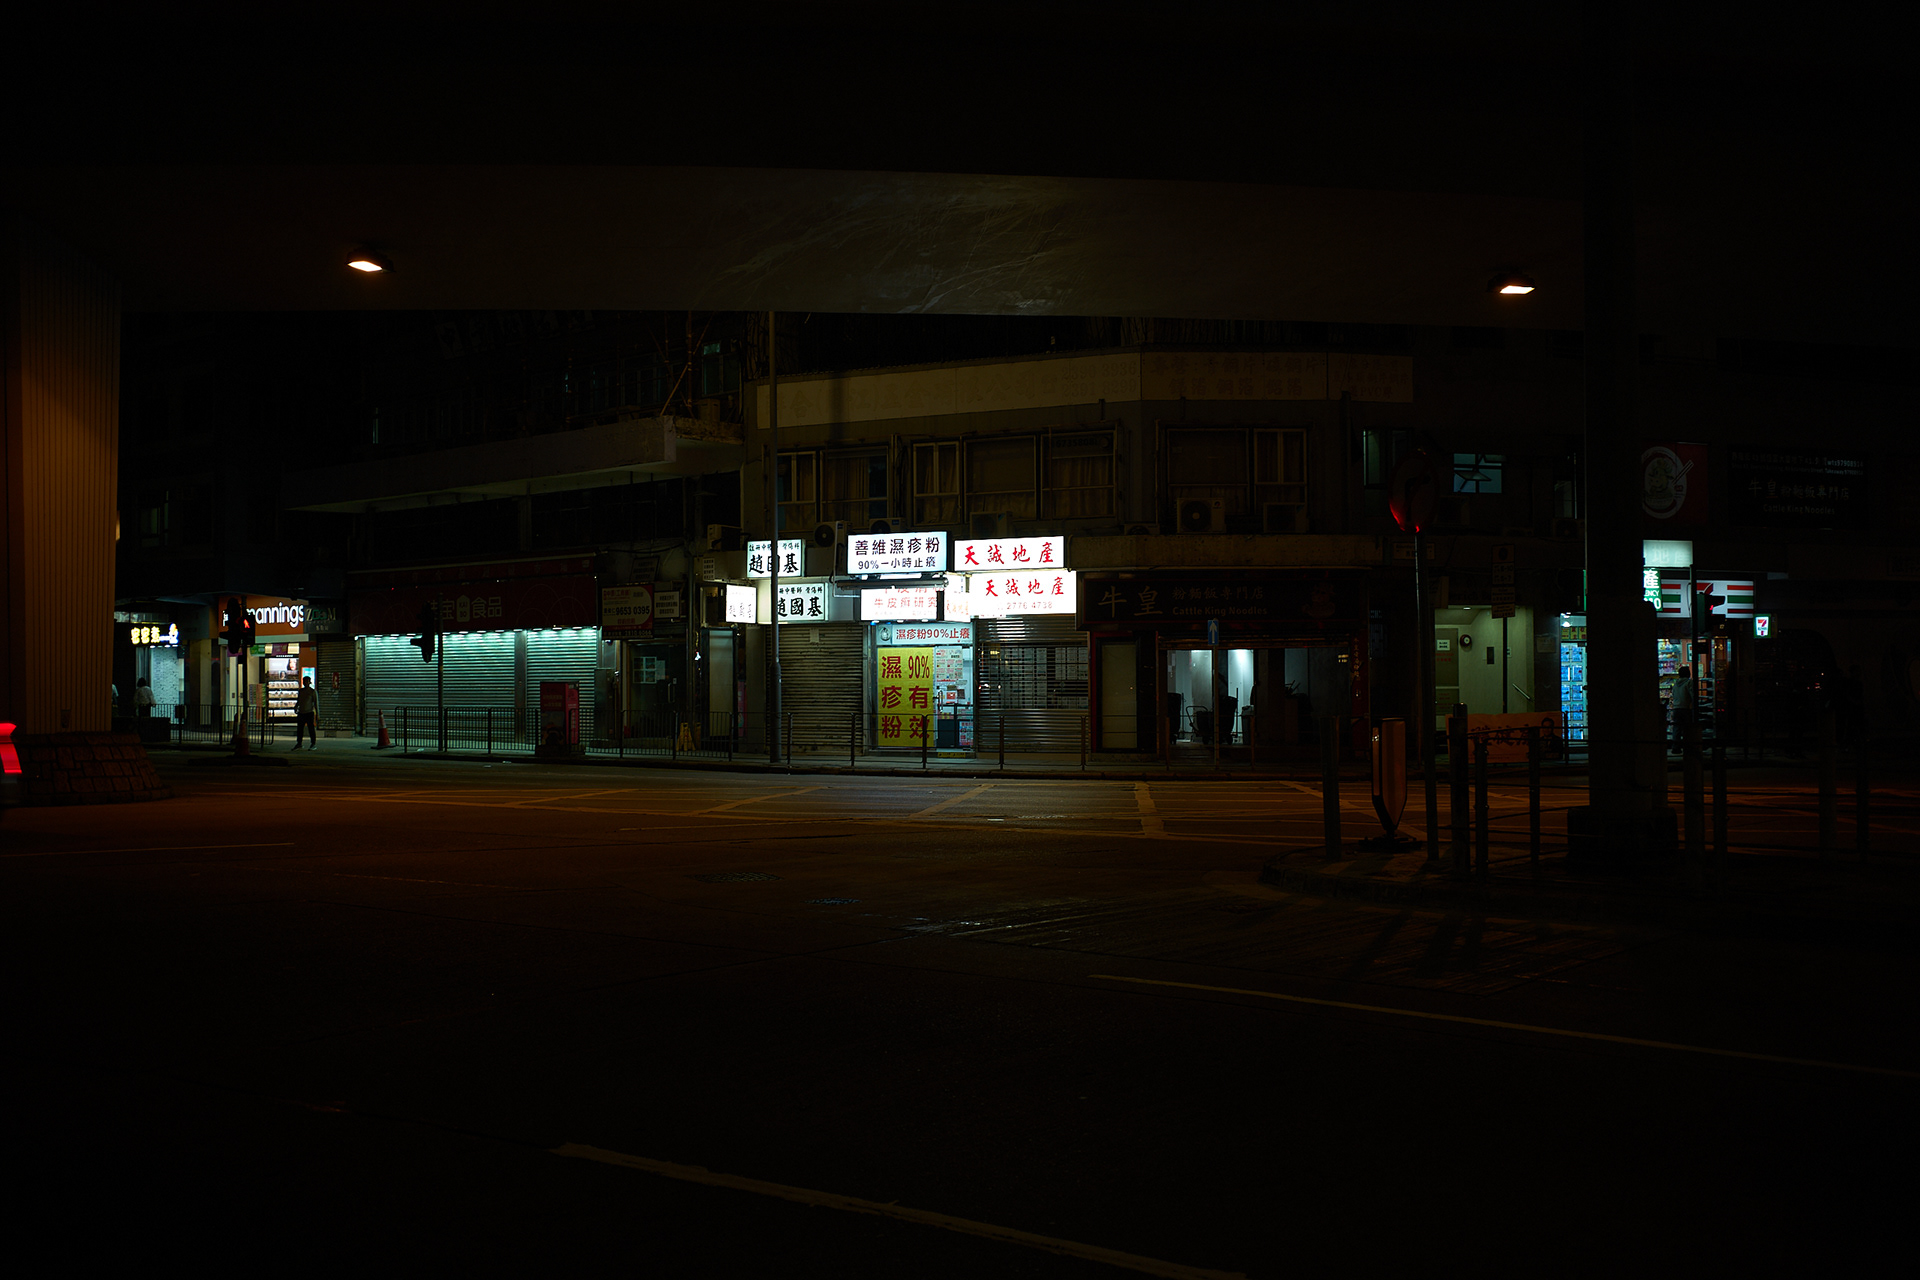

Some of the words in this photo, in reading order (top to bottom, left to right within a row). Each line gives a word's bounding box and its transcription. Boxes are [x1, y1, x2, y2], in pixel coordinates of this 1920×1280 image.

[855, 537, 940, 556] 善維濕疹粉
[964, 542, 1054, 566] 天誠地產
[985, 576, 1065, 597] 天誠地產
[471, 597, 503, 619] 食品
[616, 606, 632, 616] 9653
[633, 605, 650, 615] 0395
[1097, 585, 1164, 618] 牛皇
[1171, 606, 1202, 616] Cattle
[1204, 606, 1226, 617] King
[1228, 606, 1268, 616] Noodles
[881, 656, 902, 739] 濕疹粉
